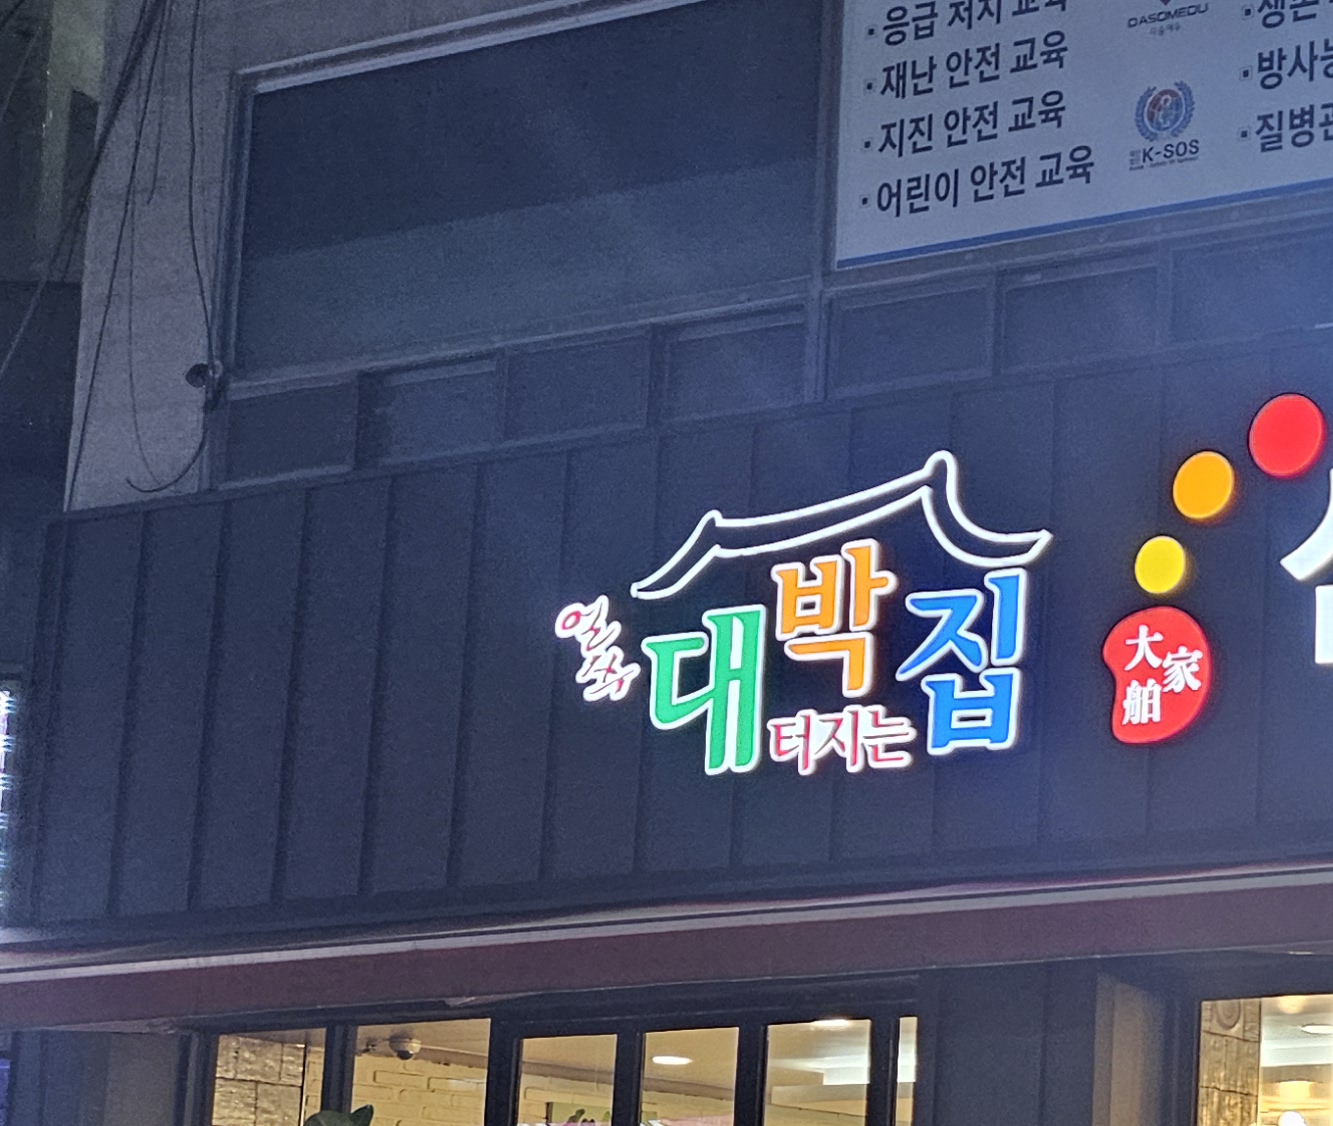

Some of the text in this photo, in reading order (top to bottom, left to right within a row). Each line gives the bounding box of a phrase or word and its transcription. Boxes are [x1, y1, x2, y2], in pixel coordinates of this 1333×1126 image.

[882, 1, 938, 46] 응급
[880, 30, 1068, 100] 재난 안전 교육
[877, 90, 1066, 158] 지진 안전 교육
[1142, 139, 1200, 163] K-SOS
[876, 144, 1096, 218] 어린이 안전 교육
[767, 703, 918, 775] 터지는
